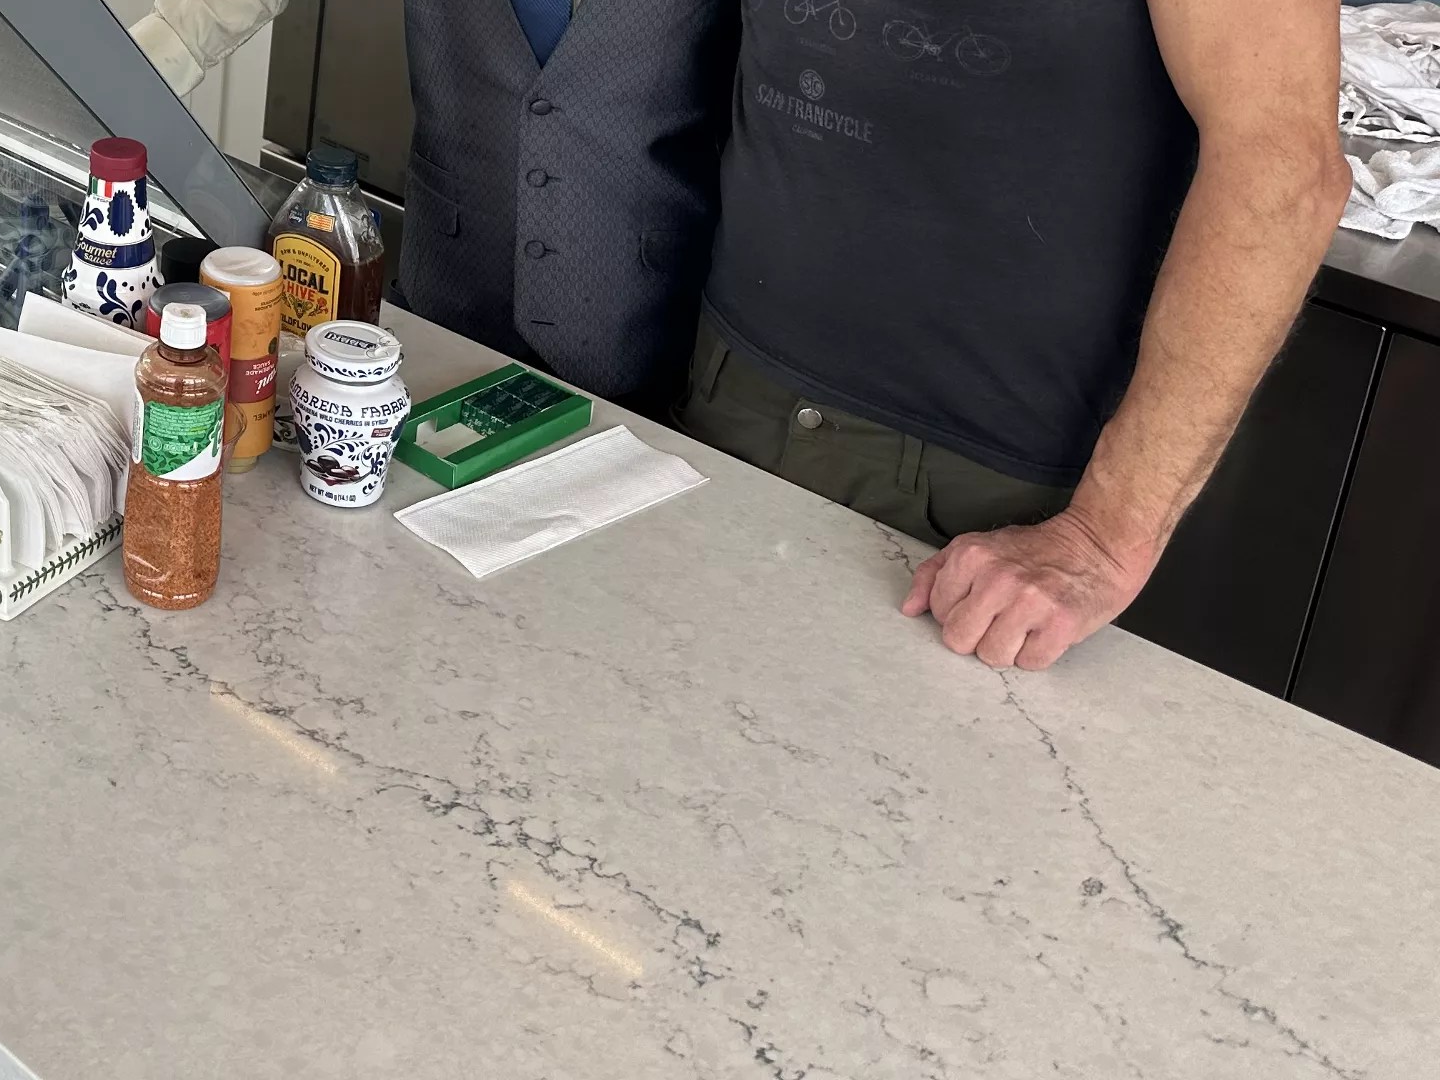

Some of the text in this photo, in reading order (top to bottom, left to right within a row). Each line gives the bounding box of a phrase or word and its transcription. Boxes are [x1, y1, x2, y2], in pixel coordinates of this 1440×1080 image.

[755, 83, 874, 145] SAN FRANCYCLE
[75, 232, 117, 259] Gourmet
[83, 252, 113, 266] sauce
[286, 282, 318, 303] HIVE
